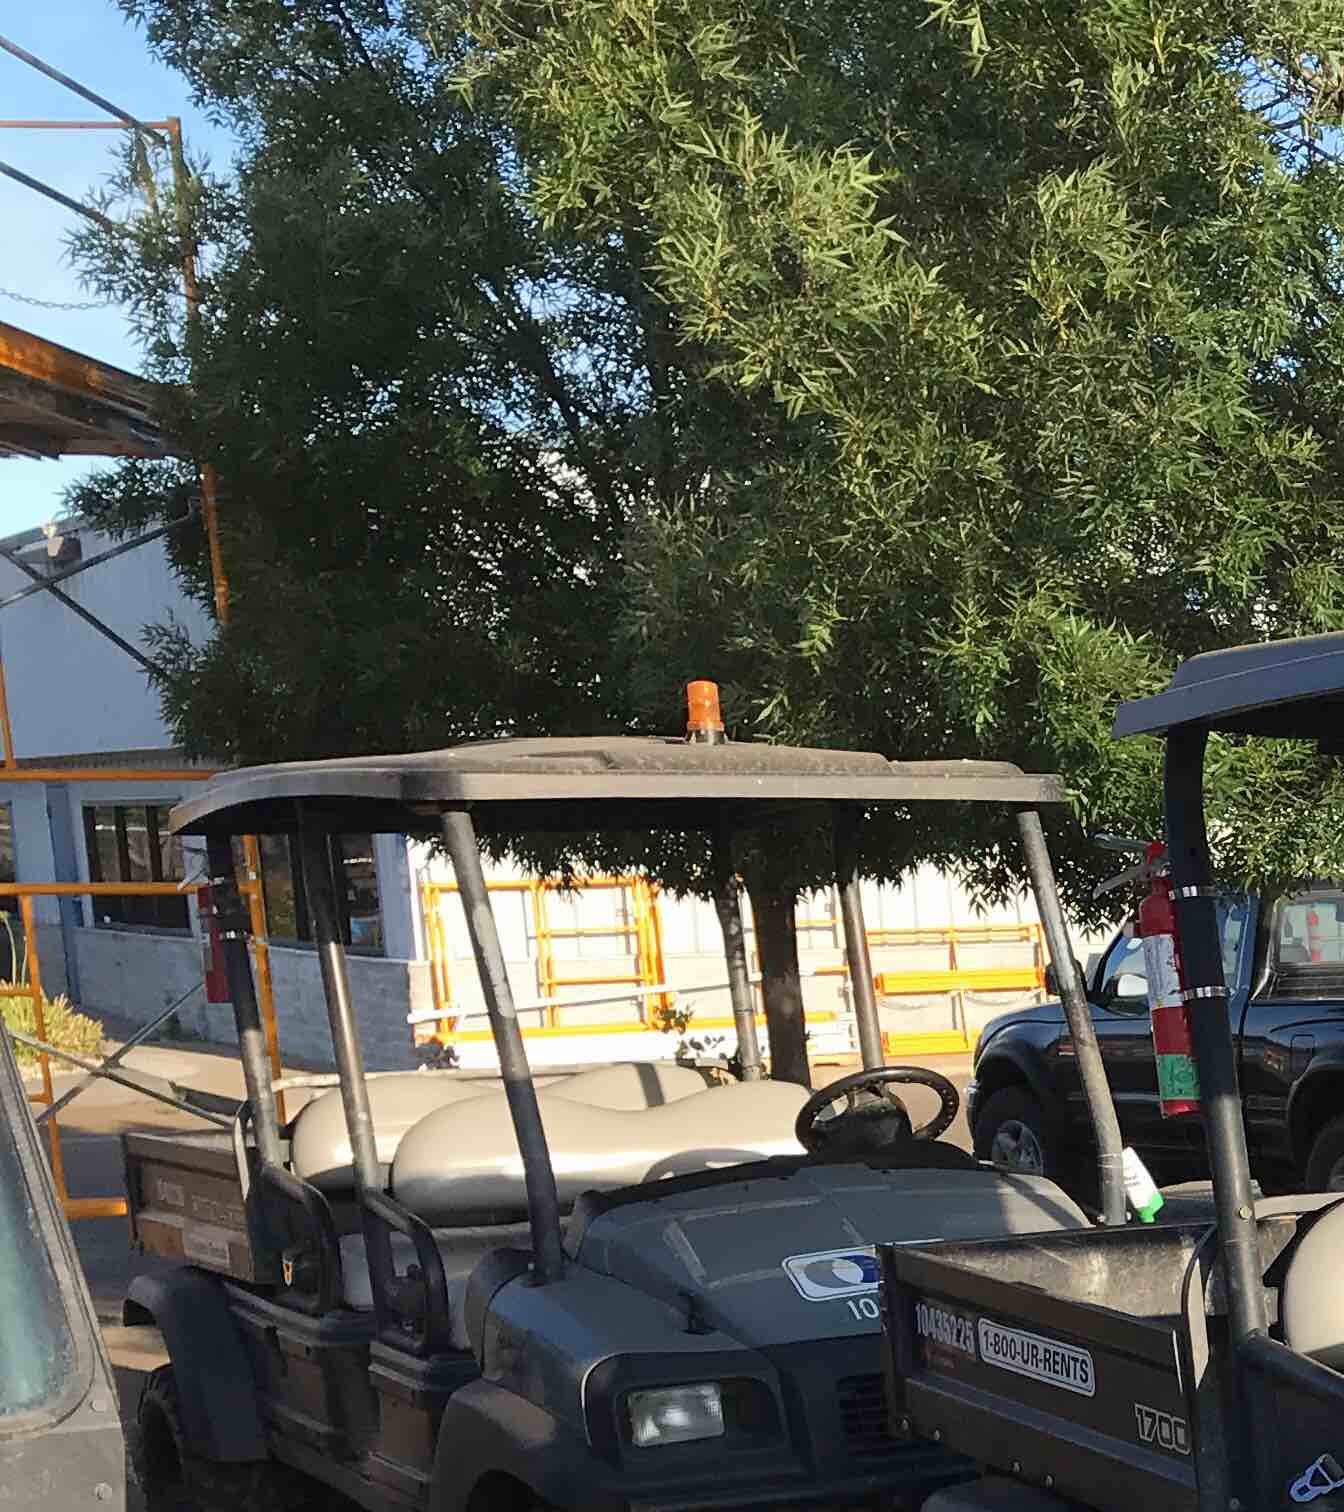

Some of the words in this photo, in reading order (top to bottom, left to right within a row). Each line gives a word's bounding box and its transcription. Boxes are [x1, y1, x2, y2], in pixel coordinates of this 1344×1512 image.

[915, 1303, 976, 1353] 10435225
[983, 1330, 1090, 1384] 1-800-UR-RENTS
[1133, 1403, 1192, 1456] 1700
